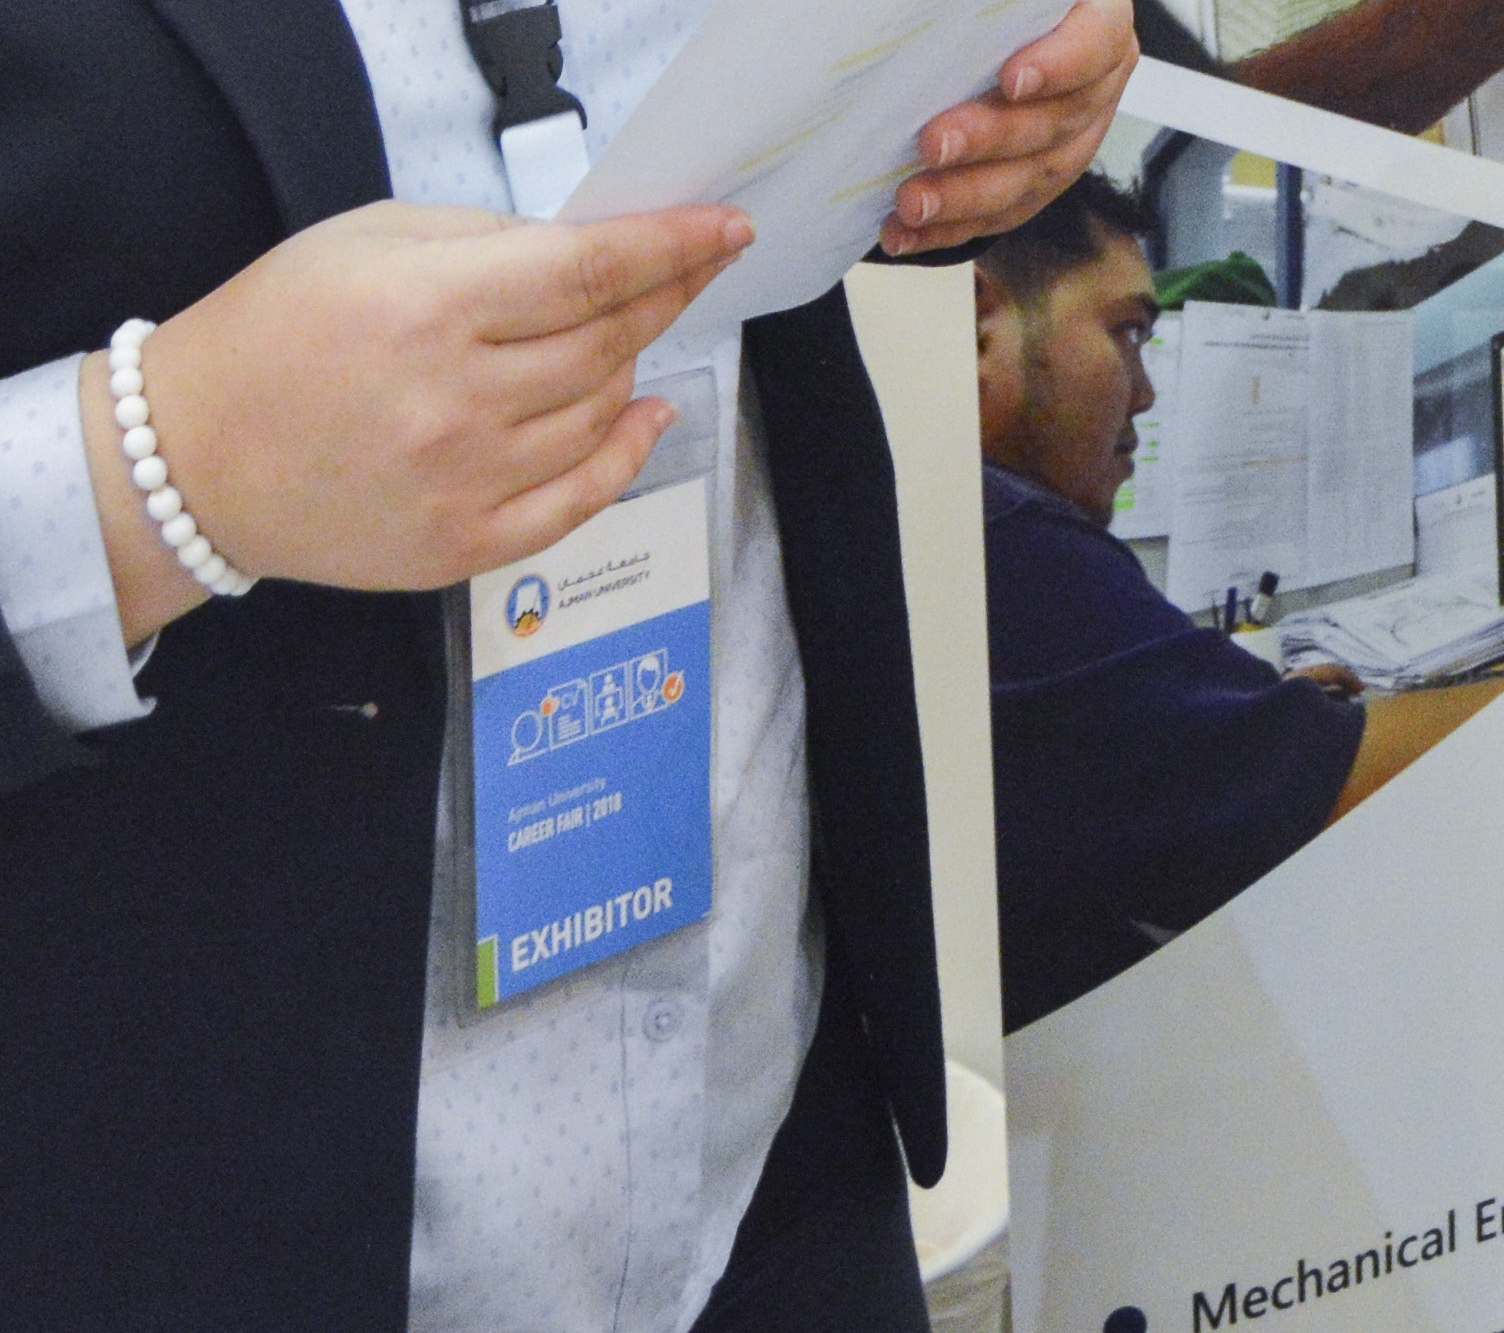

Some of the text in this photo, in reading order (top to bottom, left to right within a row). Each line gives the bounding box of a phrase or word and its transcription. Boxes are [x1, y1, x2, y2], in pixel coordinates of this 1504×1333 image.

[508, 817, 554, 853] CAREER
[557, 805, 583, 834] FAIR
[511, 877, 673, 973] EXHIBITOR
[1192, 1210, 1458, 1333] Mechanical
